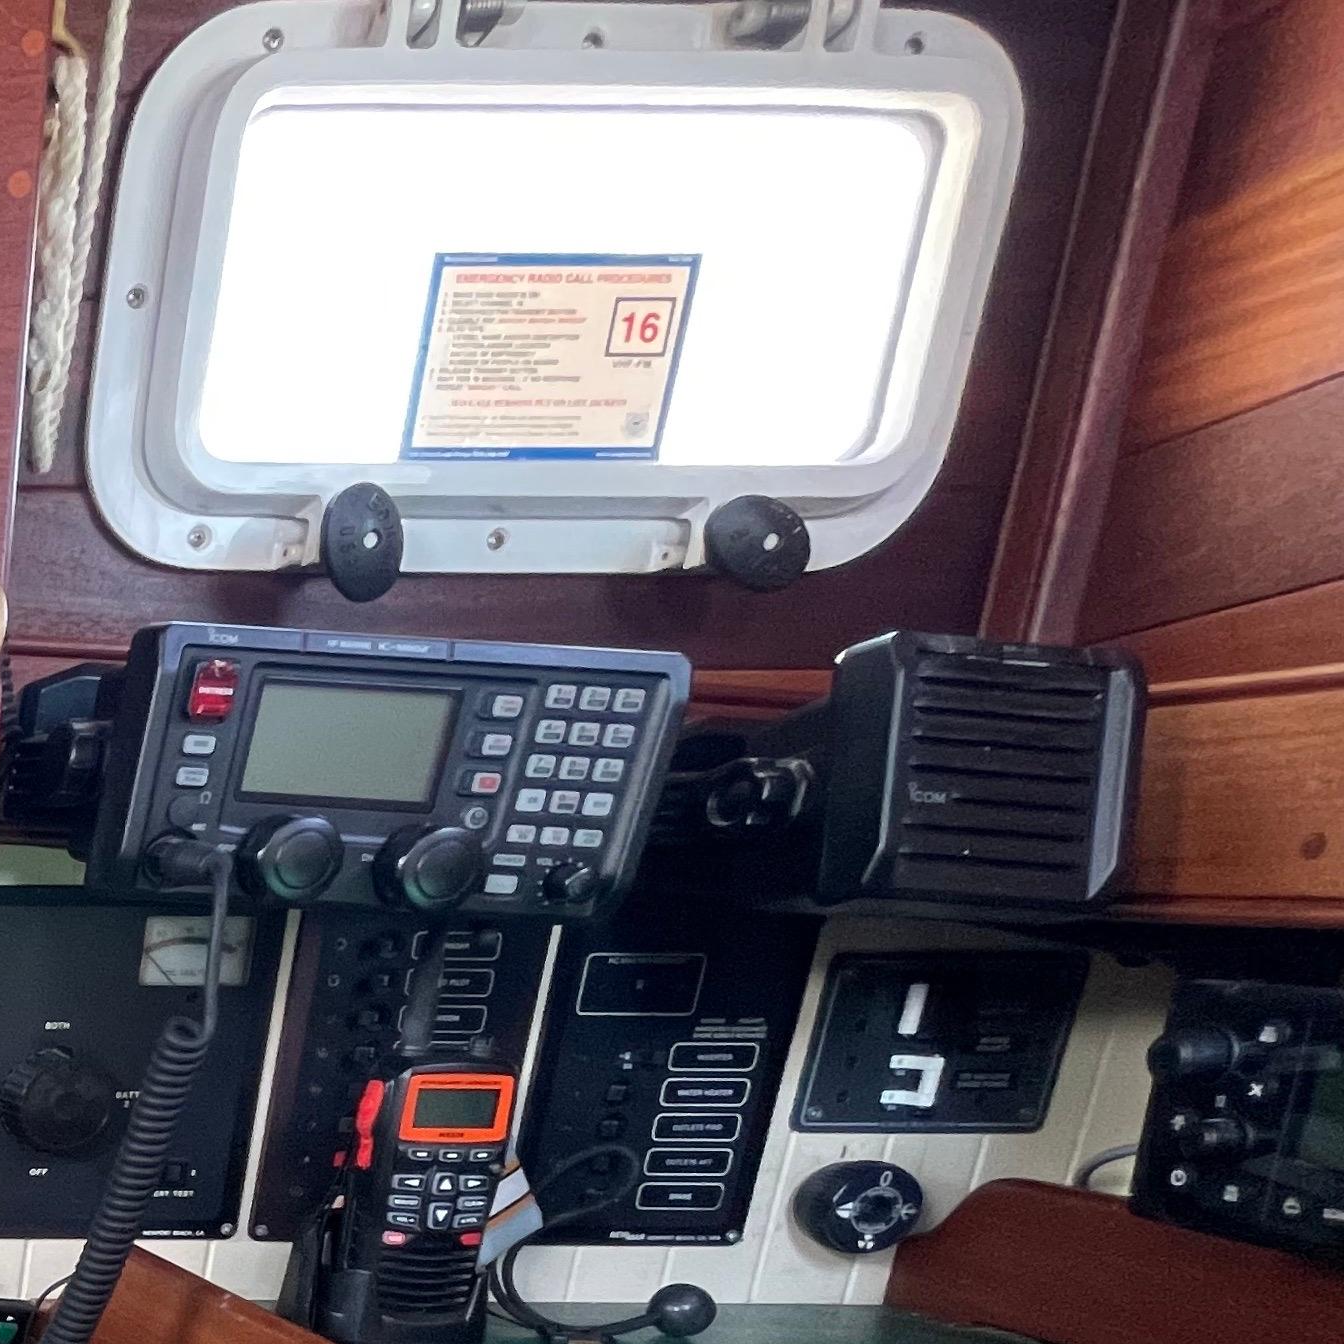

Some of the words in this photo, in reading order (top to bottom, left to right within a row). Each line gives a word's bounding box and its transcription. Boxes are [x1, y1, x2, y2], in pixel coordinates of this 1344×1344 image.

[527, 274, 564, 284] RADIO
[565, 274, 593, 284] CALL
[621, 312, 660, 343] 16
[45, 1021, 71, 1030] BOTH
[115, 1091, 140, 1099] BATT
[29, 1168, 48, 1176] OFF
